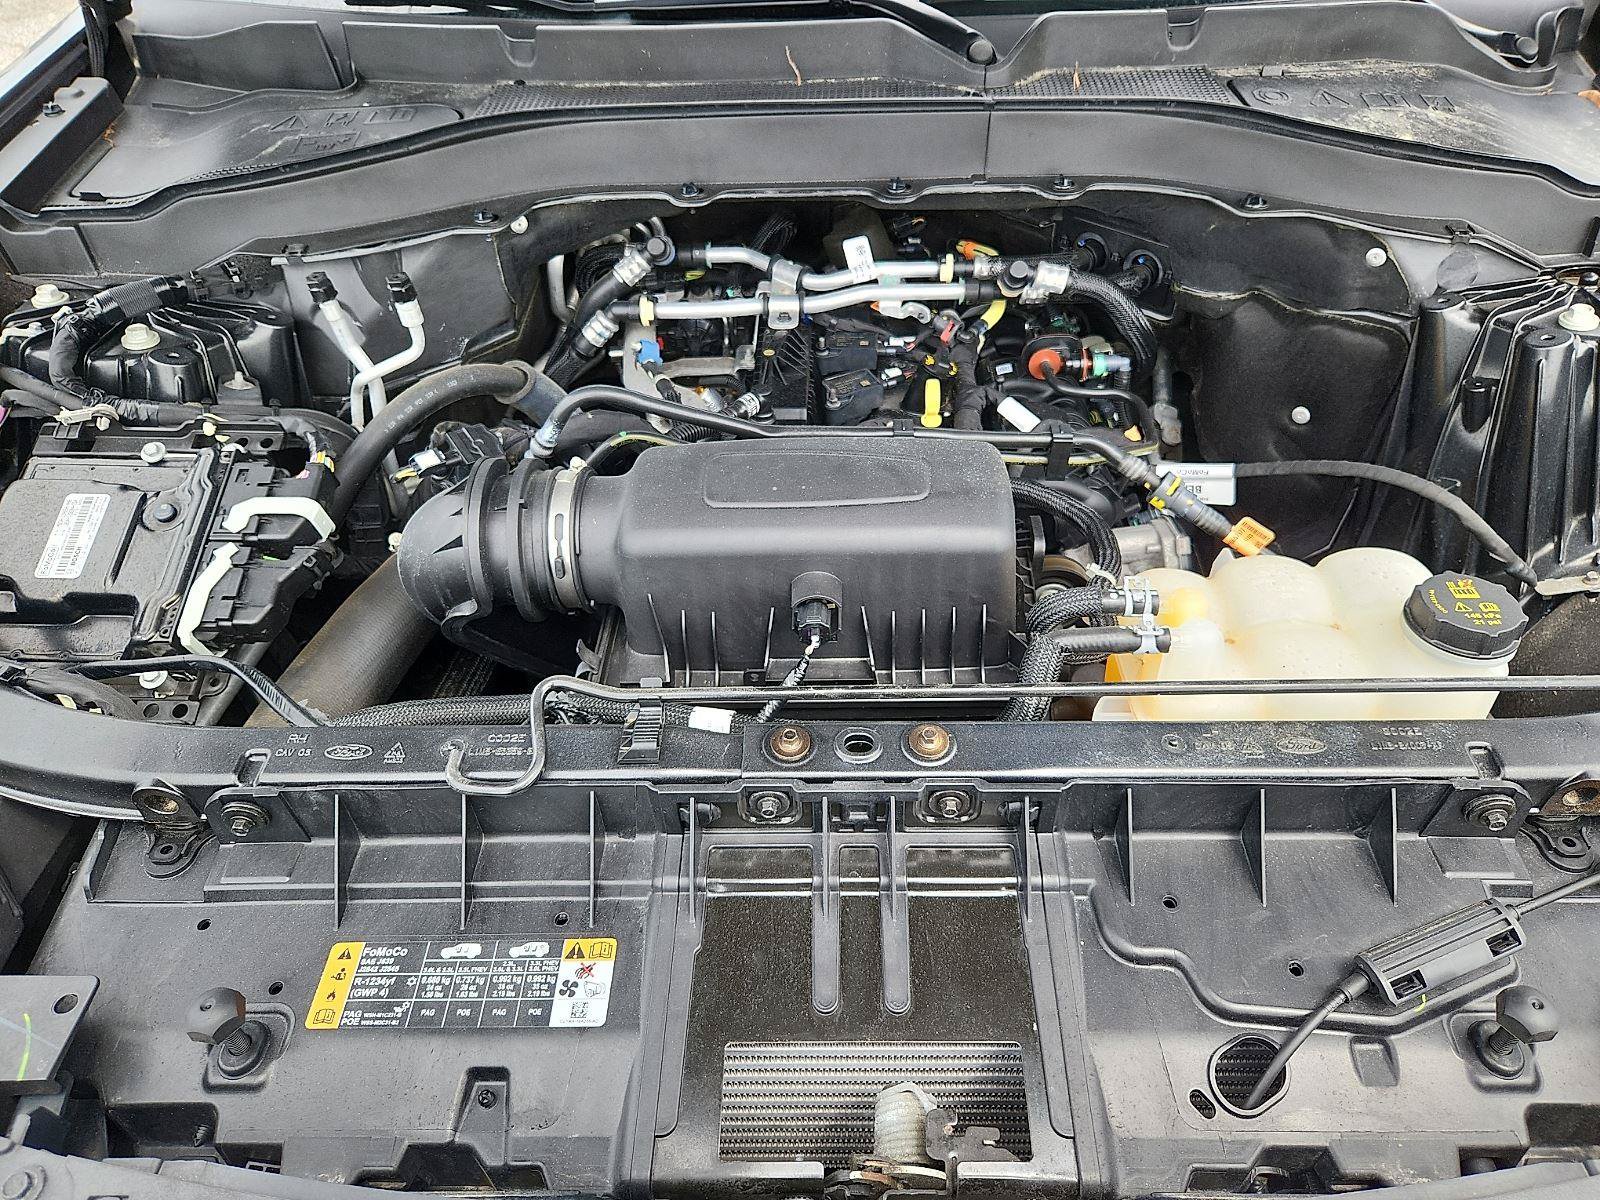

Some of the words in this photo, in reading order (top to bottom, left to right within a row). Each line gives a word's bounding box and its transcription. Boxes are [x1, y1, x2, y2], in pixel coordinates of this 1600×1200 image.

[286, 733, 309, 744] RH
[275, 748, 294, 757] CAV
[363, 946, 408, 957] FoMoCo
[354, 976, 396, 987] R-1234yf
[441, 976, 451, 986] kg
[456, 976, 475, 984] 0.737
[476, 976, 486, 985] kg
[492, 975, 512, 983] 0.992
[513, 975, 522, 984] kg
[527, 975, 546, 983] 0.992
[547, 975, 556, 984] kg
[349, 987, 378, 999] (GWP
[379, 987, 389, 999] 4)
[343, 1010, 362, 1018] PAG
[528, 1008, 542, 1016] POE
[340, 1018, 360, 1026] POE
